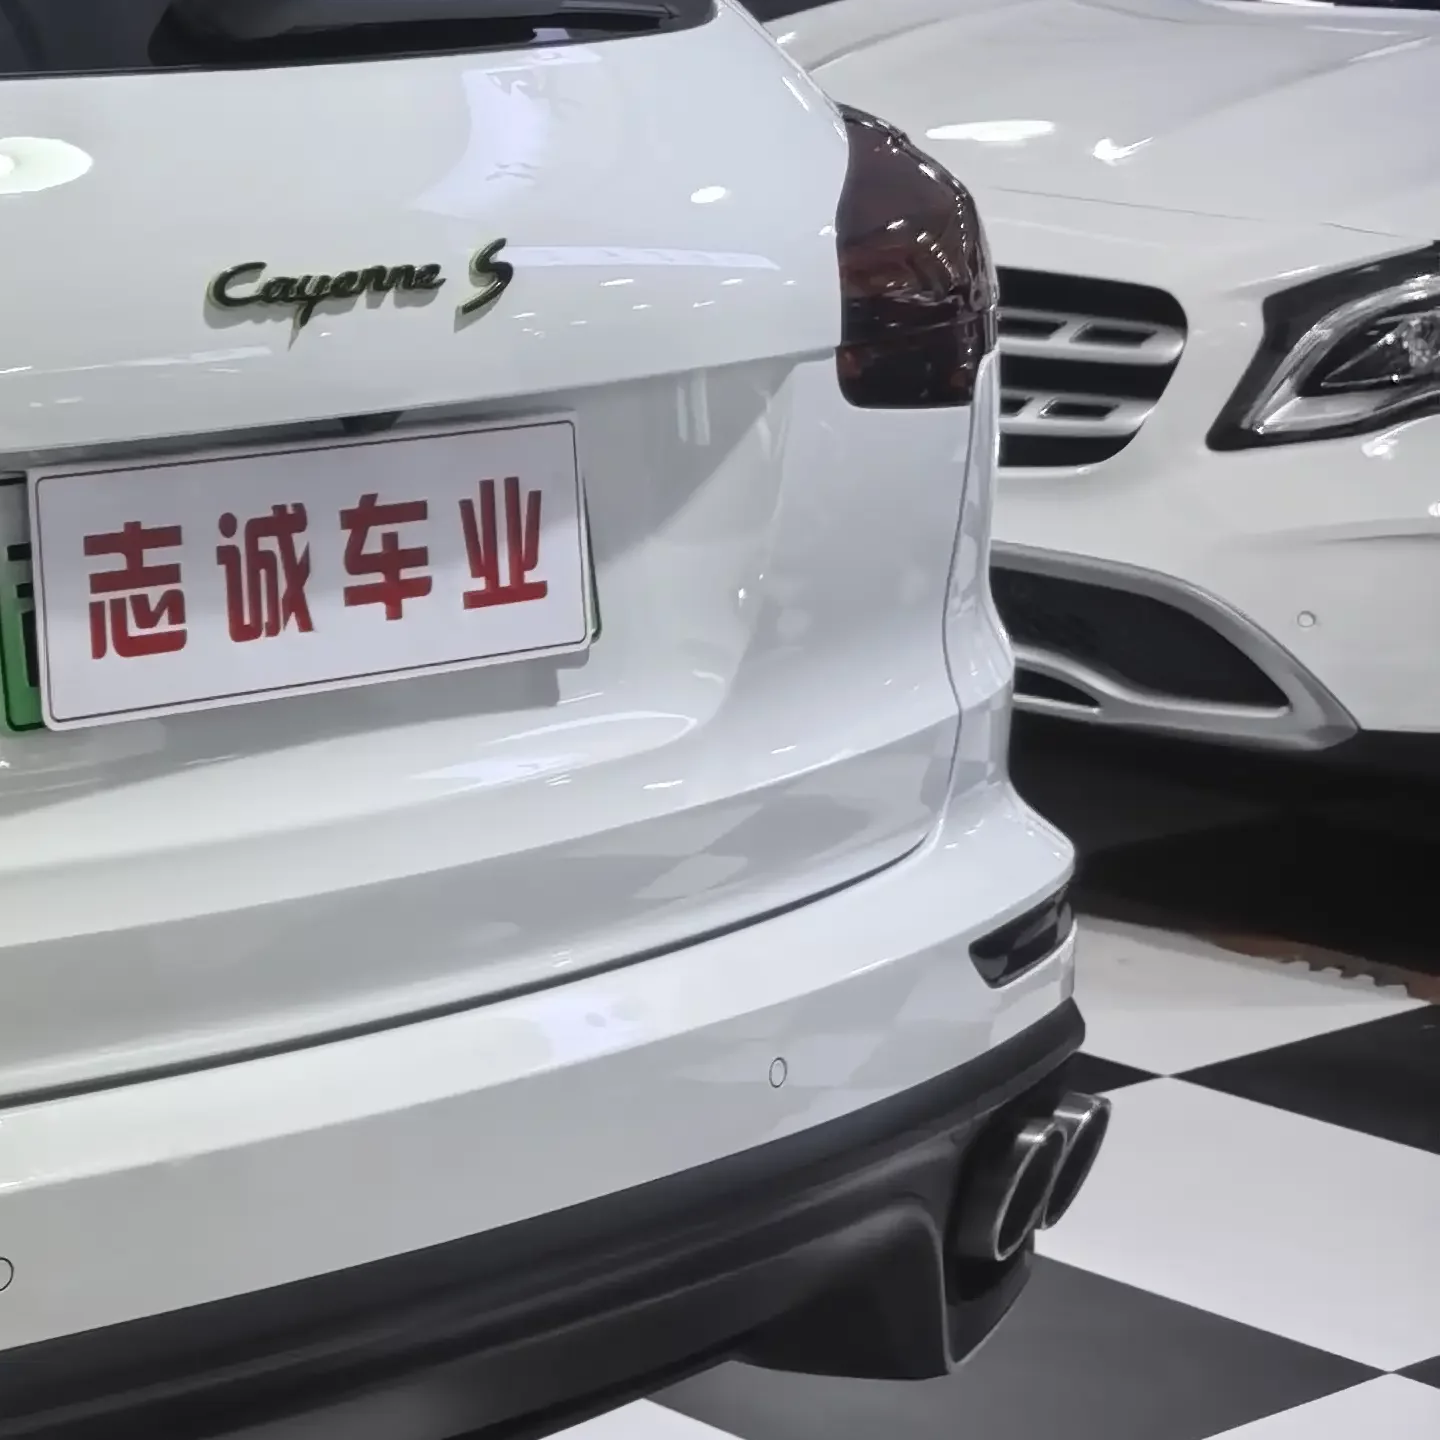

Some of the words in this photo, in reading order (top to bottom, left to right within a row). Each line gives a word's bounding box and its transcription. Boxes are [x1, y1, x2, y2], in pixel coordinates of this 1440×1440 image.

[205, 261, 447, 328] Cayenne
[458, 237, 514, 316] S
[82, 476, 549, 660] 志诚车业
